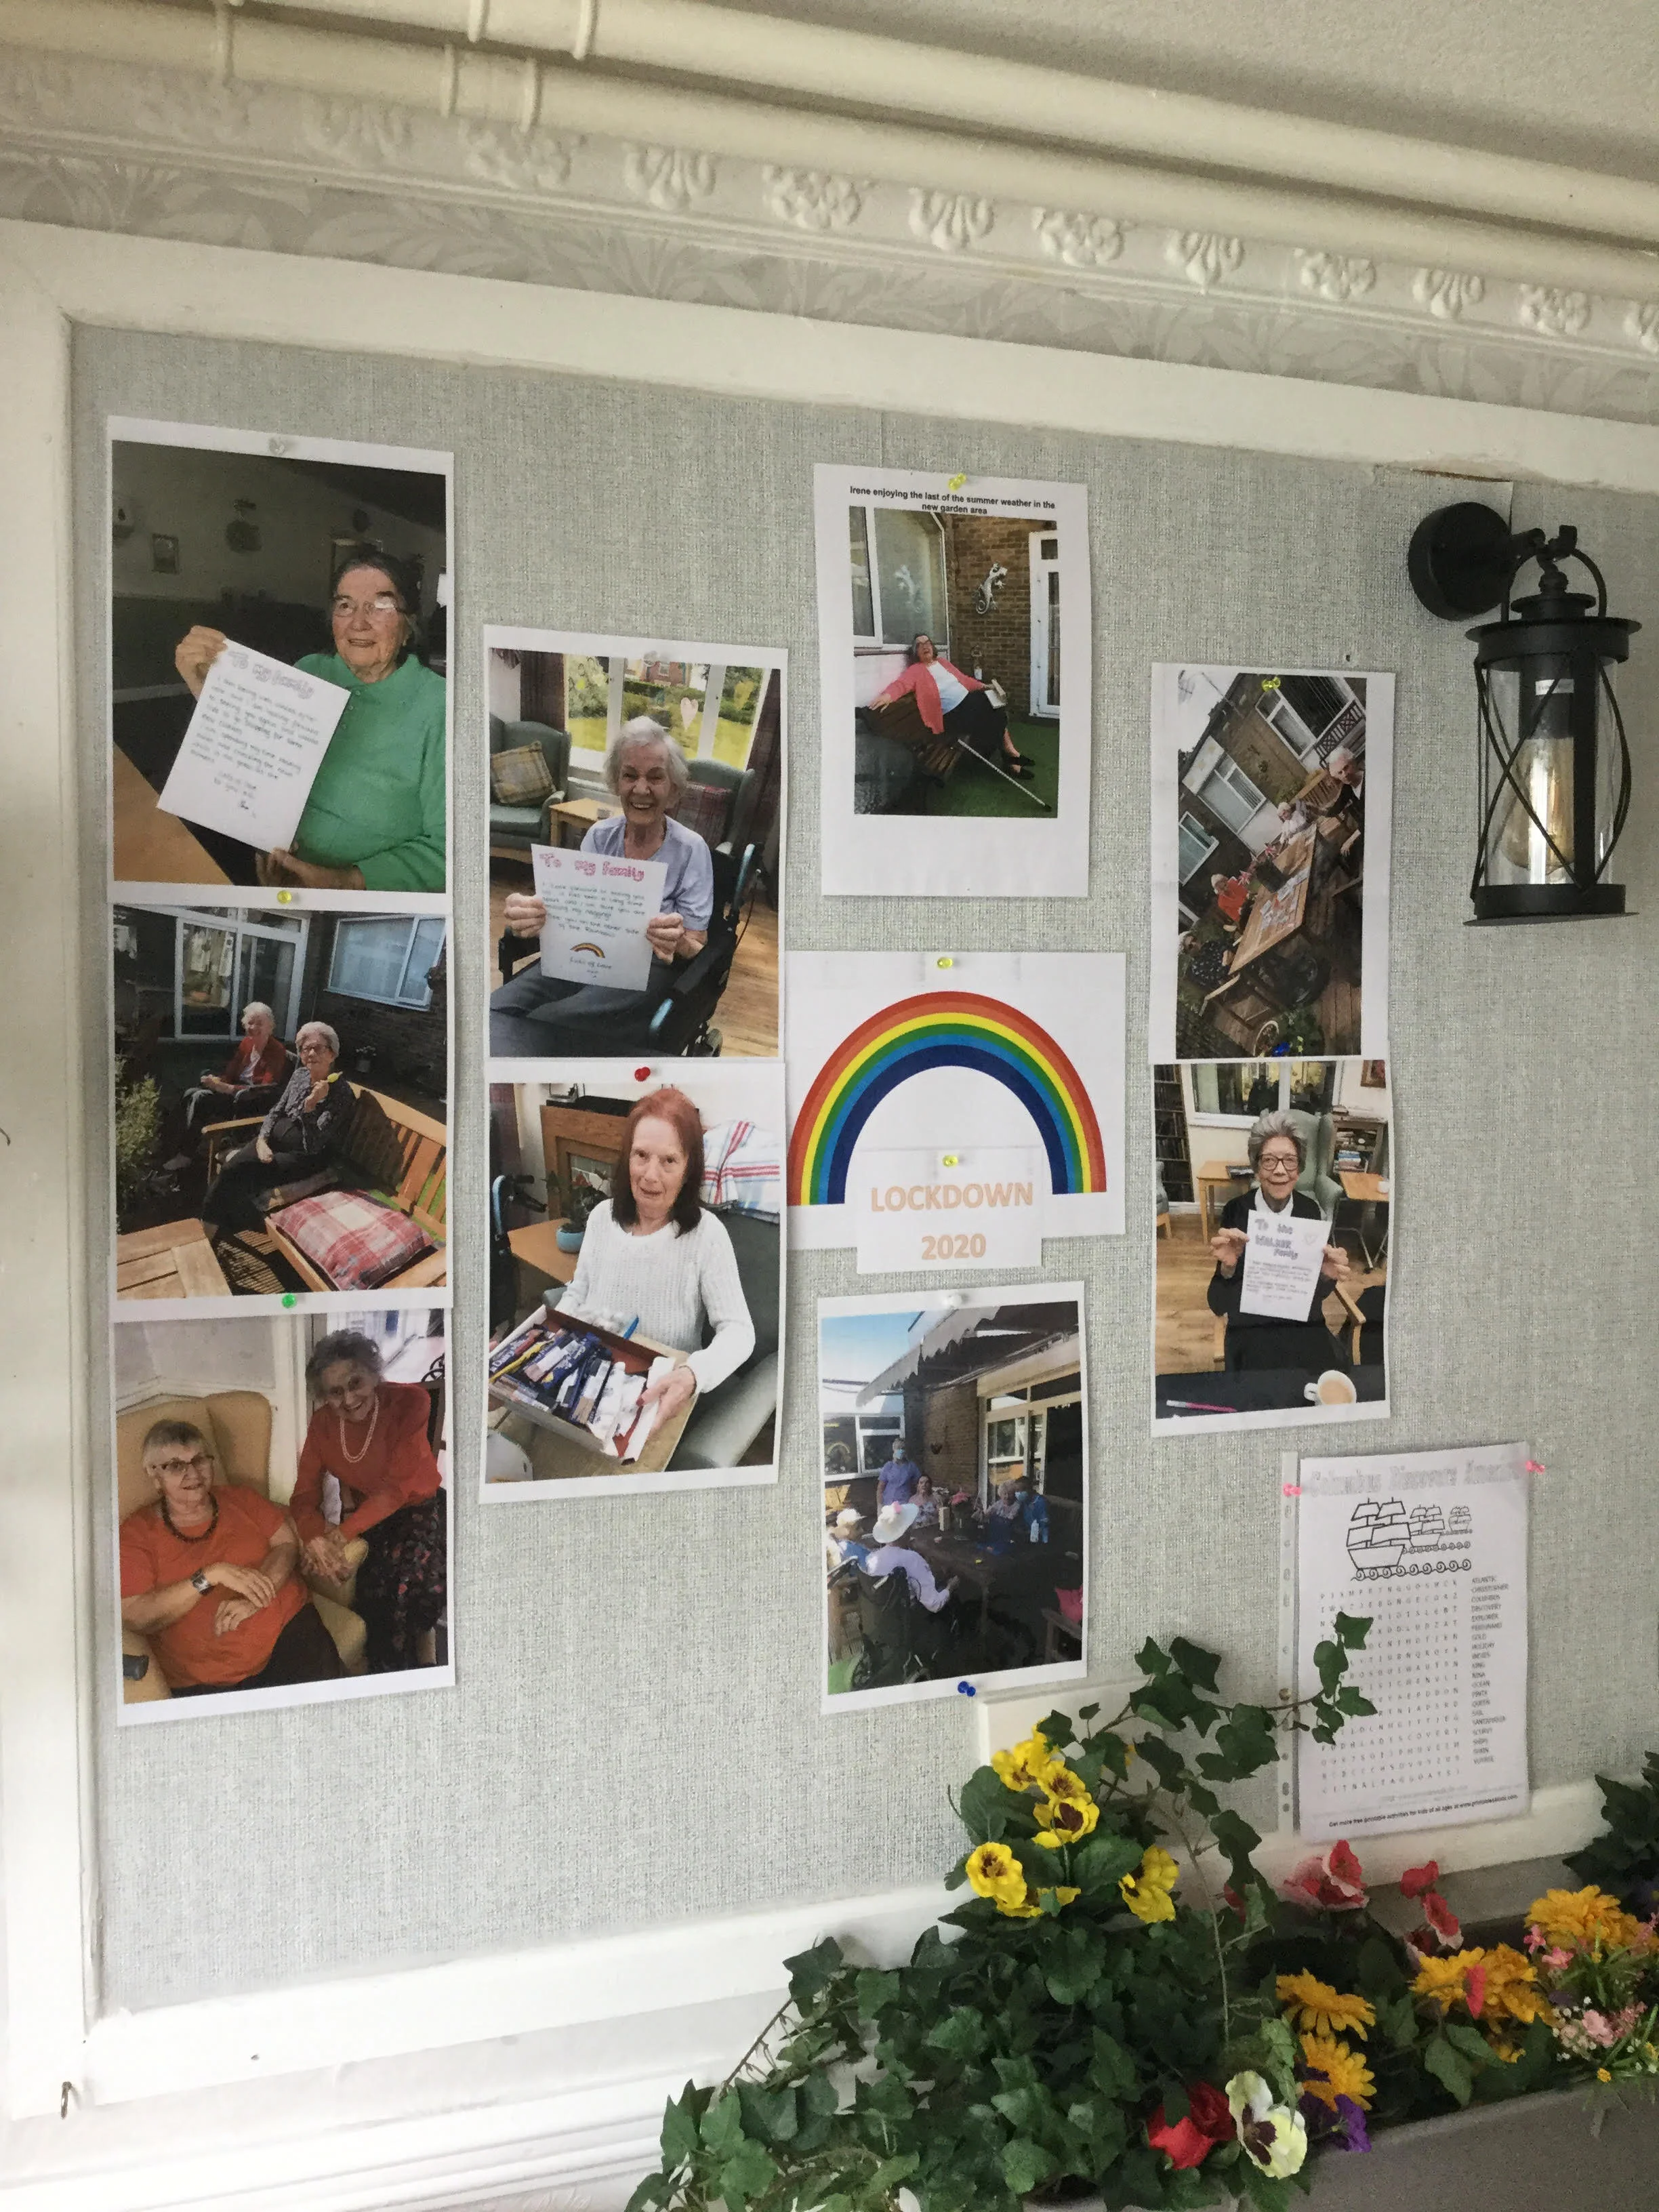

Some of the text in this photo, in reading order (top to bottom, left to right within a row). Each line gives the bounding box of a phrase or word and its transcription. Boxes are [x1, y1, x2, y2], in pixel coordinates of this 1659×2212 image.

[850, 486, 1055, 509] Irene enjoying the last of the summer weather in the
[922, 503, 939, 511] new
[940, 504, 968, 513] garden
[574, 860, 596, 876] my
[602, 861, 644, 882] family
[872, 1182, 1033, 1212] LOCKDOWN
[921, 1233, 987, 1260] 2020
